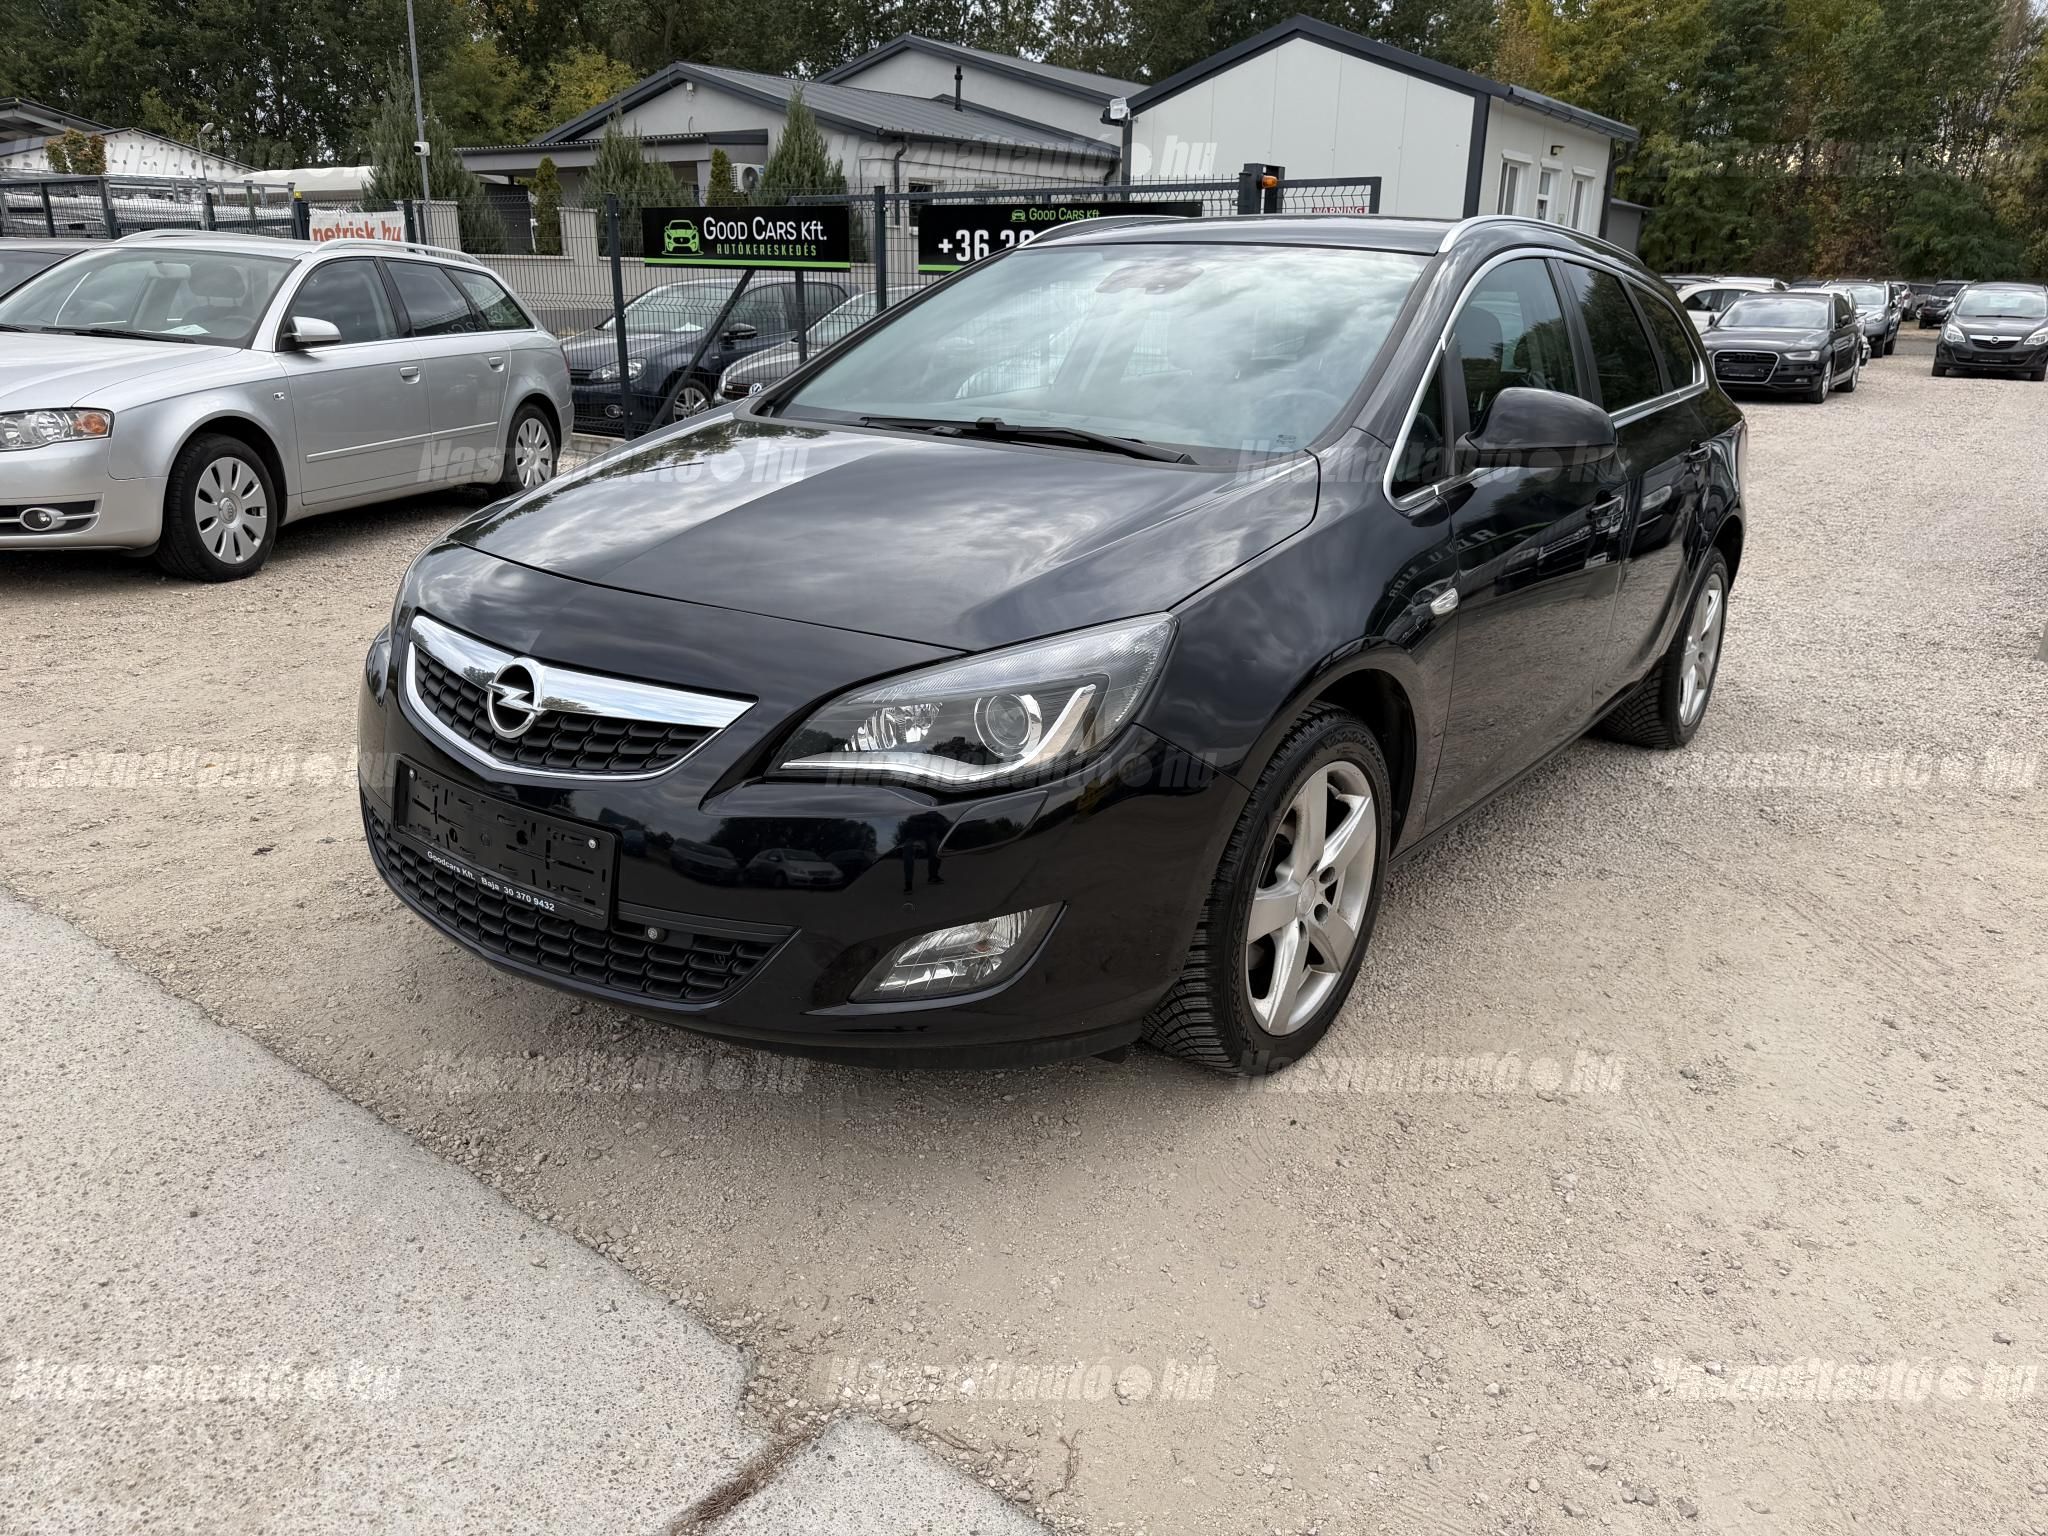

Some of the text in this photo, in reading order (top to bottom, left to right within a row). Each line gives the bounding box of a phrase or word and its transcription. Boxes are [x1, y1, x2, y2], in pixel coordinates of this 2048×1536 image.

[1029, 207, 1056, 221] GOOD
[1058, 207, 1085, 221] CARS
[1312, 206, 1364, 214] WARNING
[703, 216, 828, 241] GOOD CARS Kft.
[716, 242, 817, 256] AUTÓKERESKEDÉS
[938, 229, 989, 262] +36
[427, 850, 461, 874] Goodcars
[481, 877, 500, 892] Baja
[503, 886, 514, 897] 30
[516, 891, 532, 903] 370
[533, 896, 555, 912] 9432
